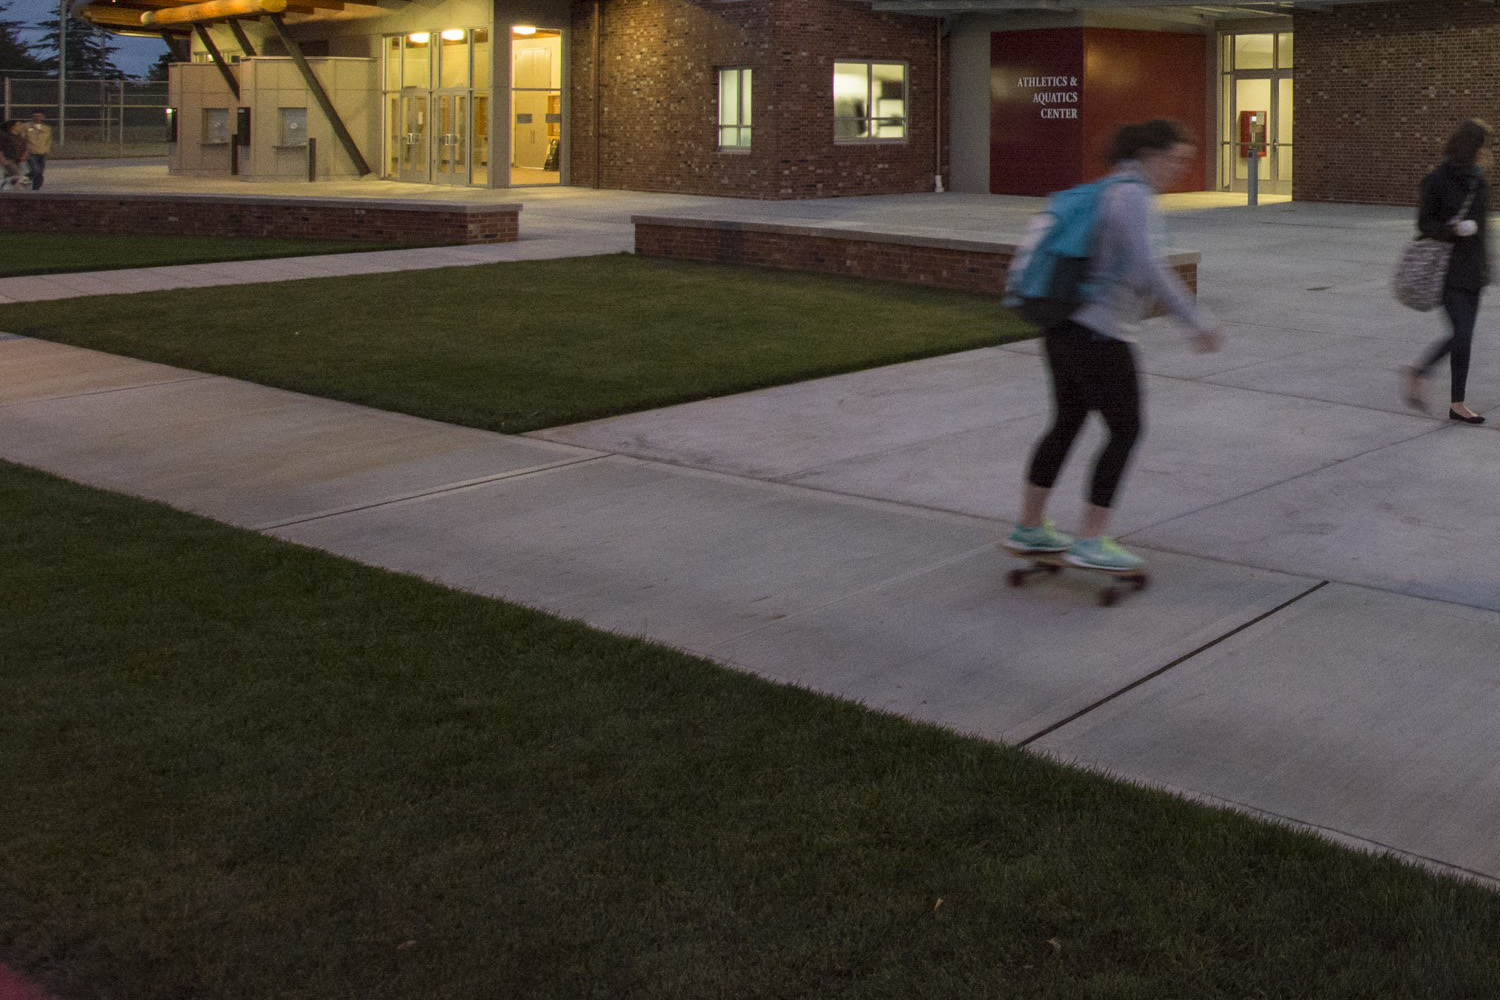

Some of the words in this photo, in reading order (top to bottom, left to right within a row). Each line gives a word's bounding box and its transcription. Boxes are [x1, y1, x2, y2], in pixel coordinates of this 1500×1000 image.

[1017, 76, 1068, 87] ATHLETICS
[1069, 76, 1077, 86] &
[1033, 92, 1078, 105] AQUATICS
[1041, 108, 1077, 119] CENTER
